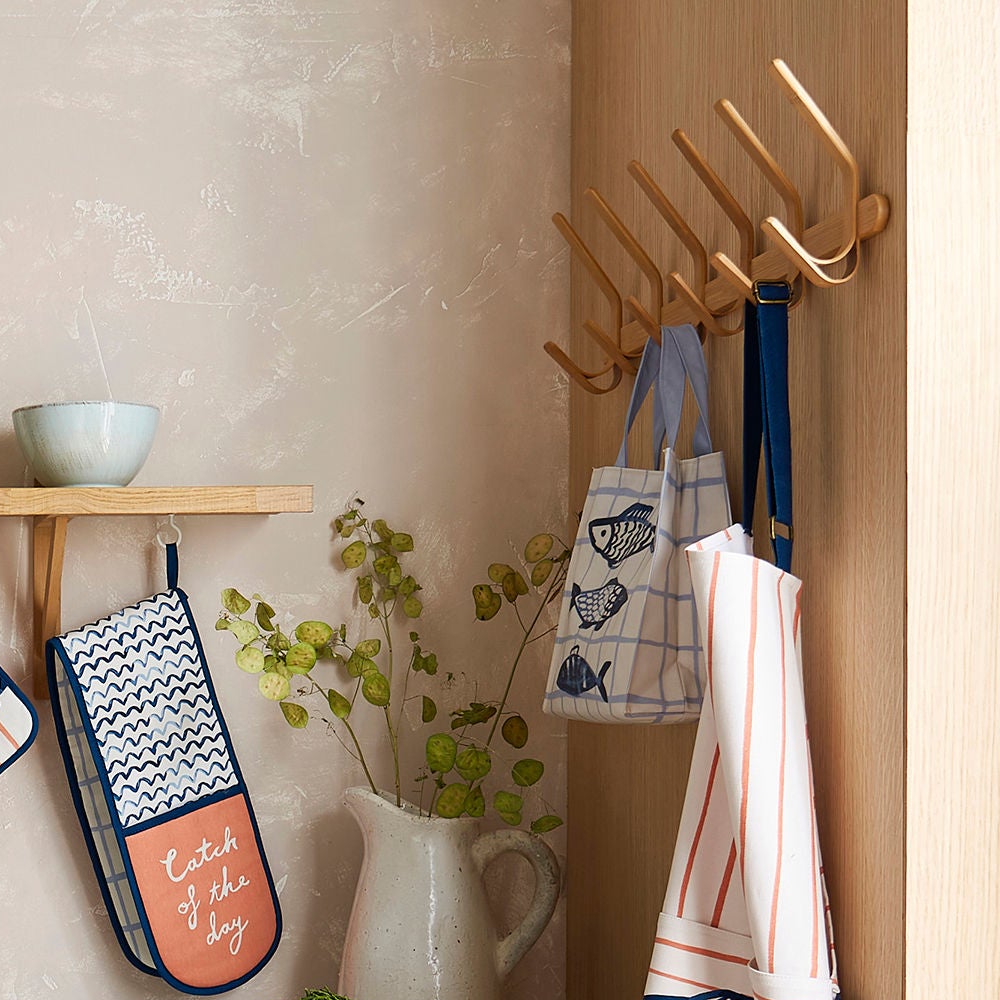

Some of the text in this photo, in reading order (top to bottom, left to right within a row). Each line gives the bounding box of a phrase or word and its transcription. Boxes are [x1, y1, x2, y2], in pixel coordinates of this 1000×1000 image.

[159, 826, 239, 883] Catch
[177, 866, 250, 930] of the
[206, 911, 249, 955] day
